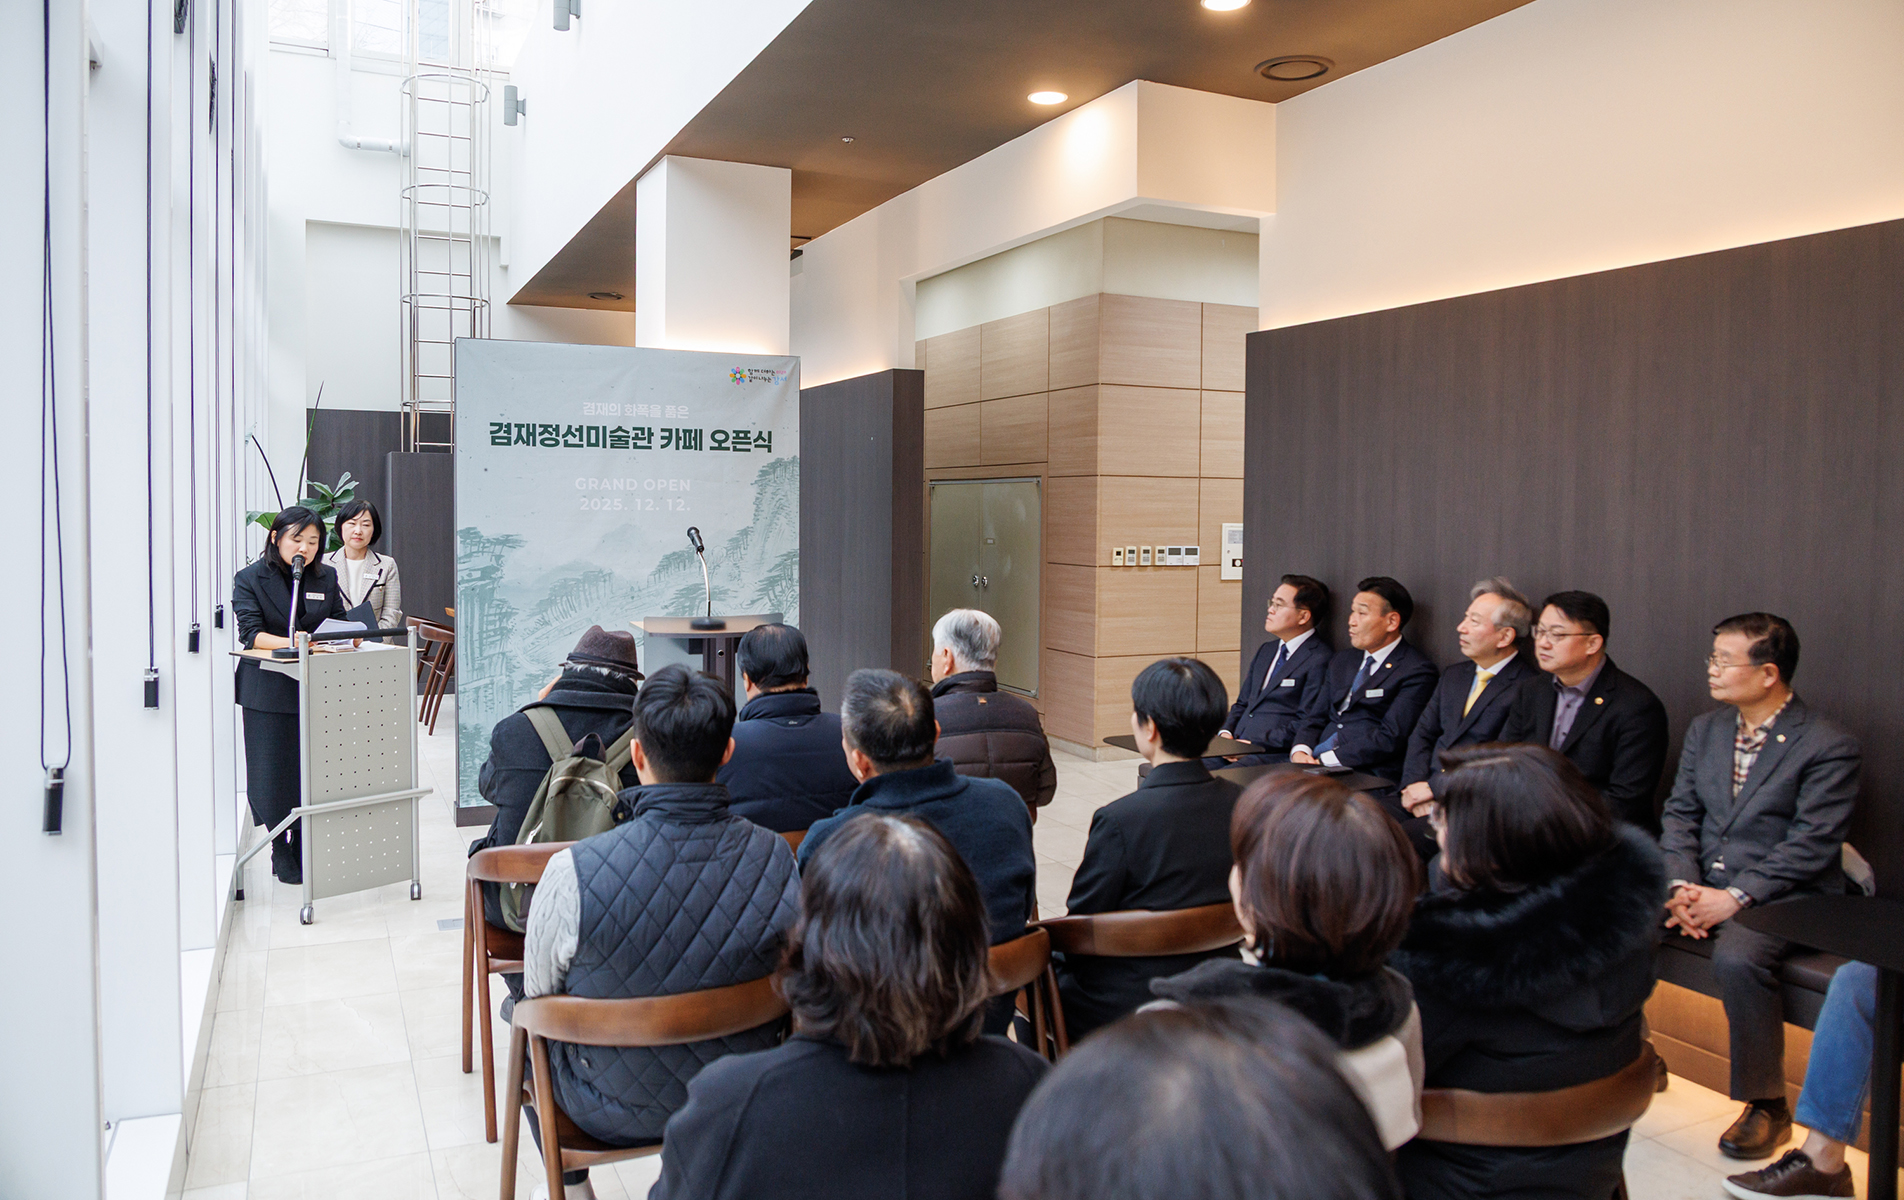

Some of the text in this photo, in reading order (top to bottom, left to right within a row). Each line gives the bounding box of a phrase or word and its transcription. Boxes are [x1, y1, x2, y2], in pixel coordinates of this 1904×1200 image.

[772, 376, 787, 386] 강서
[583, 402, 689, 419] 겸재의 화폭을 품은
[489, 422, 773, 453] 겸재정선미술관 카페 오픈식
[575, 478, 691, 492] GRAND OPEN
[580, 498, 690, 511] 2025. 12. 12.
